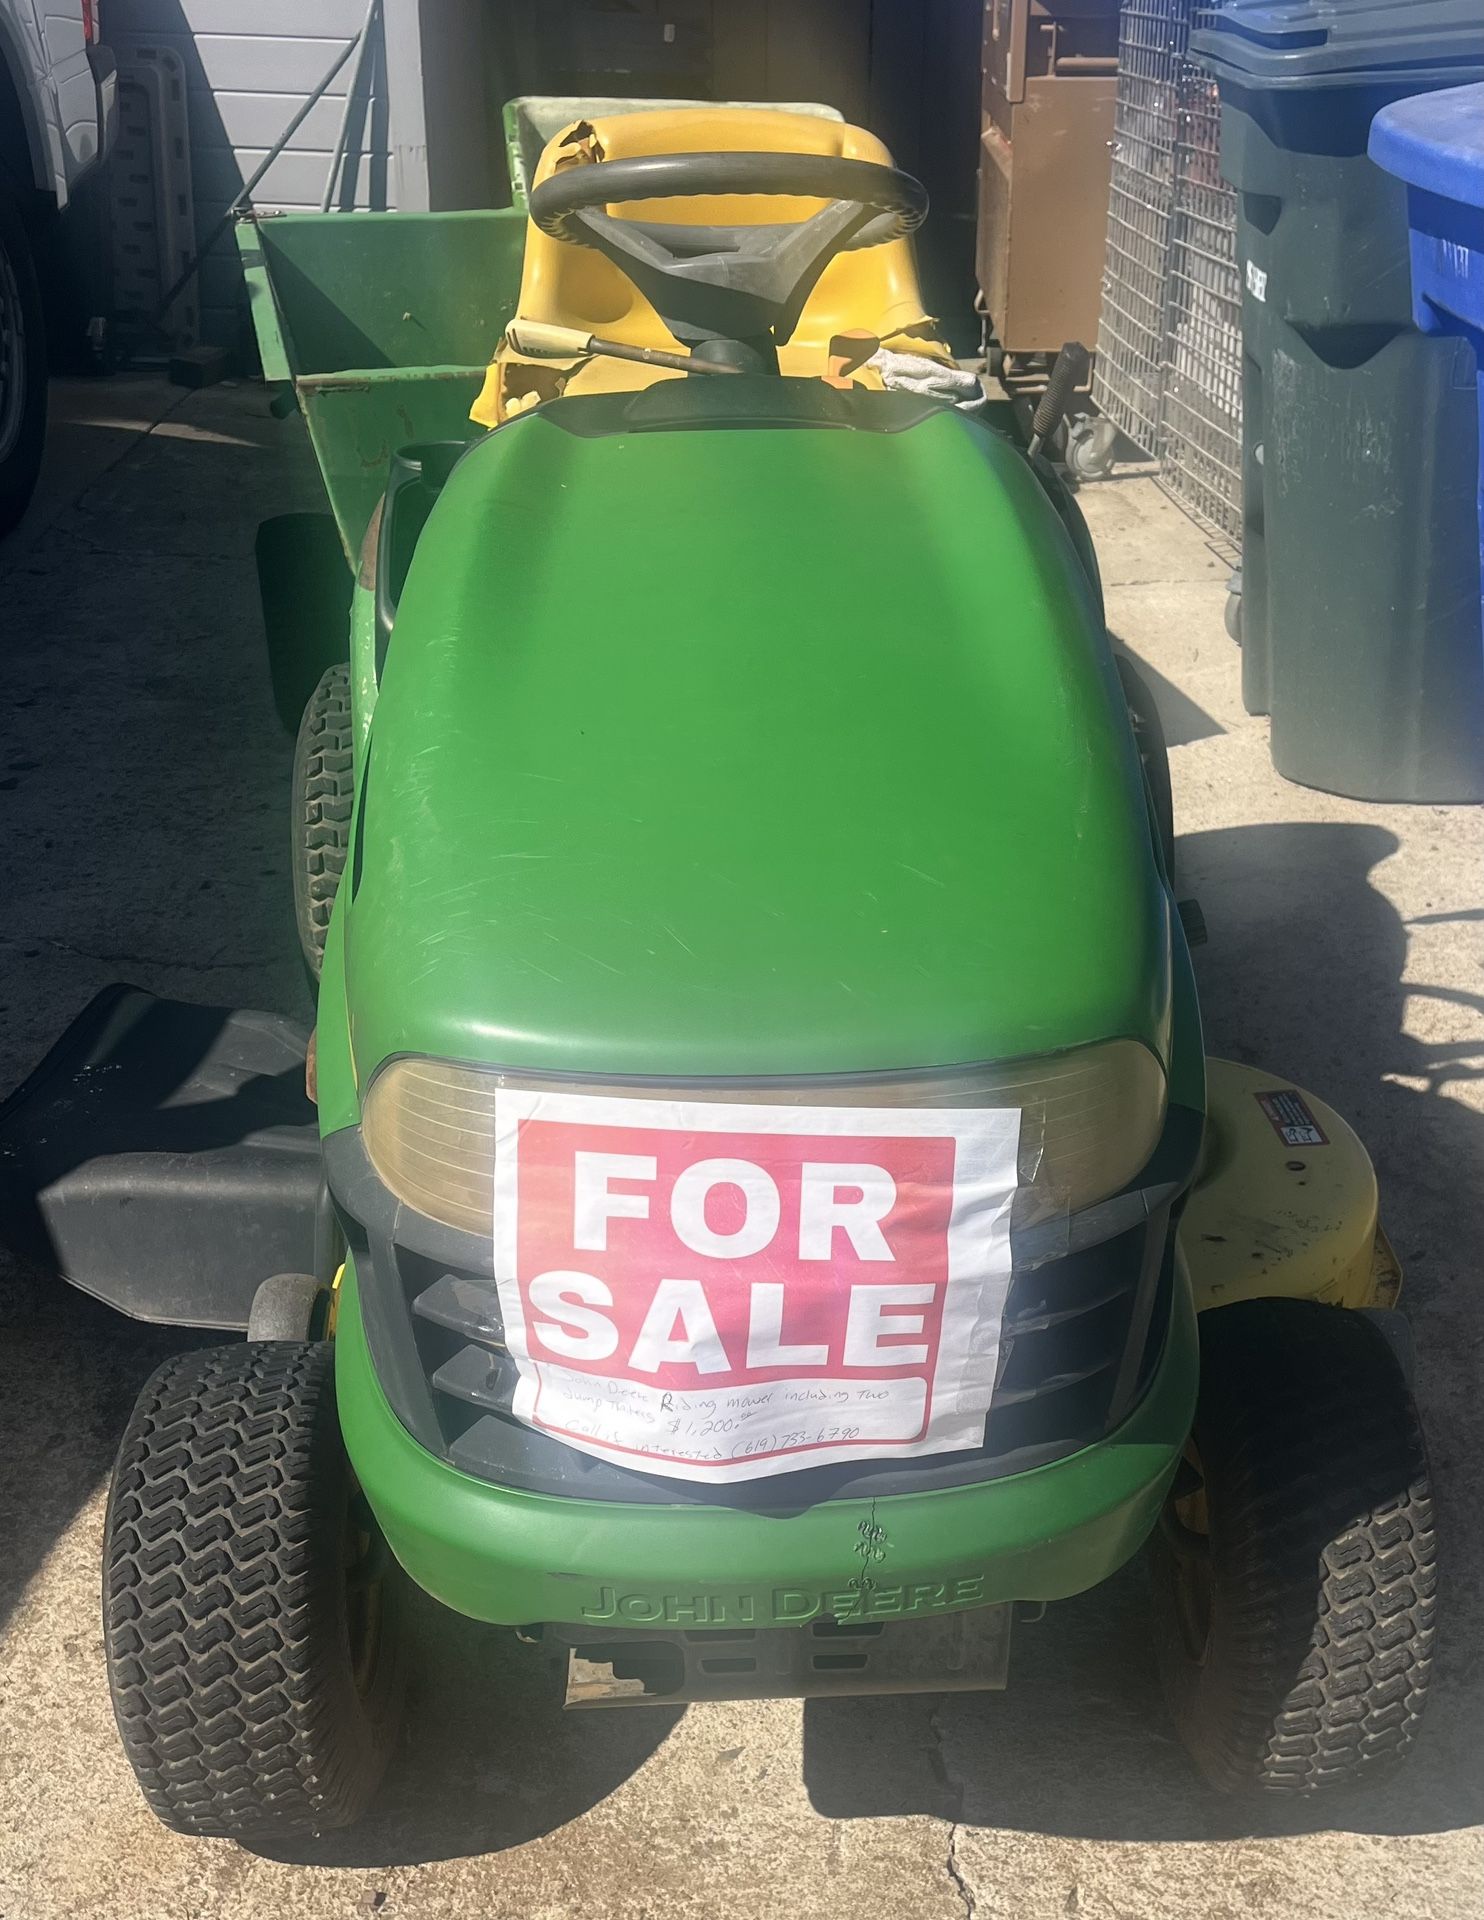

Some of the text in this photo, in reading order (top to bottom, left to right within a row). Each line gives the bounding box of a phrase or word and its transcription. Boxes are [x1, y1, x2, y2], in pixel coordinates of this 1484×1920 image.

[573, 1151, 897, 1261] FOR
[528, 1270, 937, 1375] SALE
[563, 1387, 602, 1413] dump
[660, 1392, 717, 1420] Riding
[727, 1392, 774, 1409] mower
[785, 1387, 849, 1403] including
[857, 1389, 889, 1400] Two
[565, 1419, 599, 1437] Call
[634, 1443, 723, 1460] interested
[582, 1574, 985, 1624] JOHN DEERE
